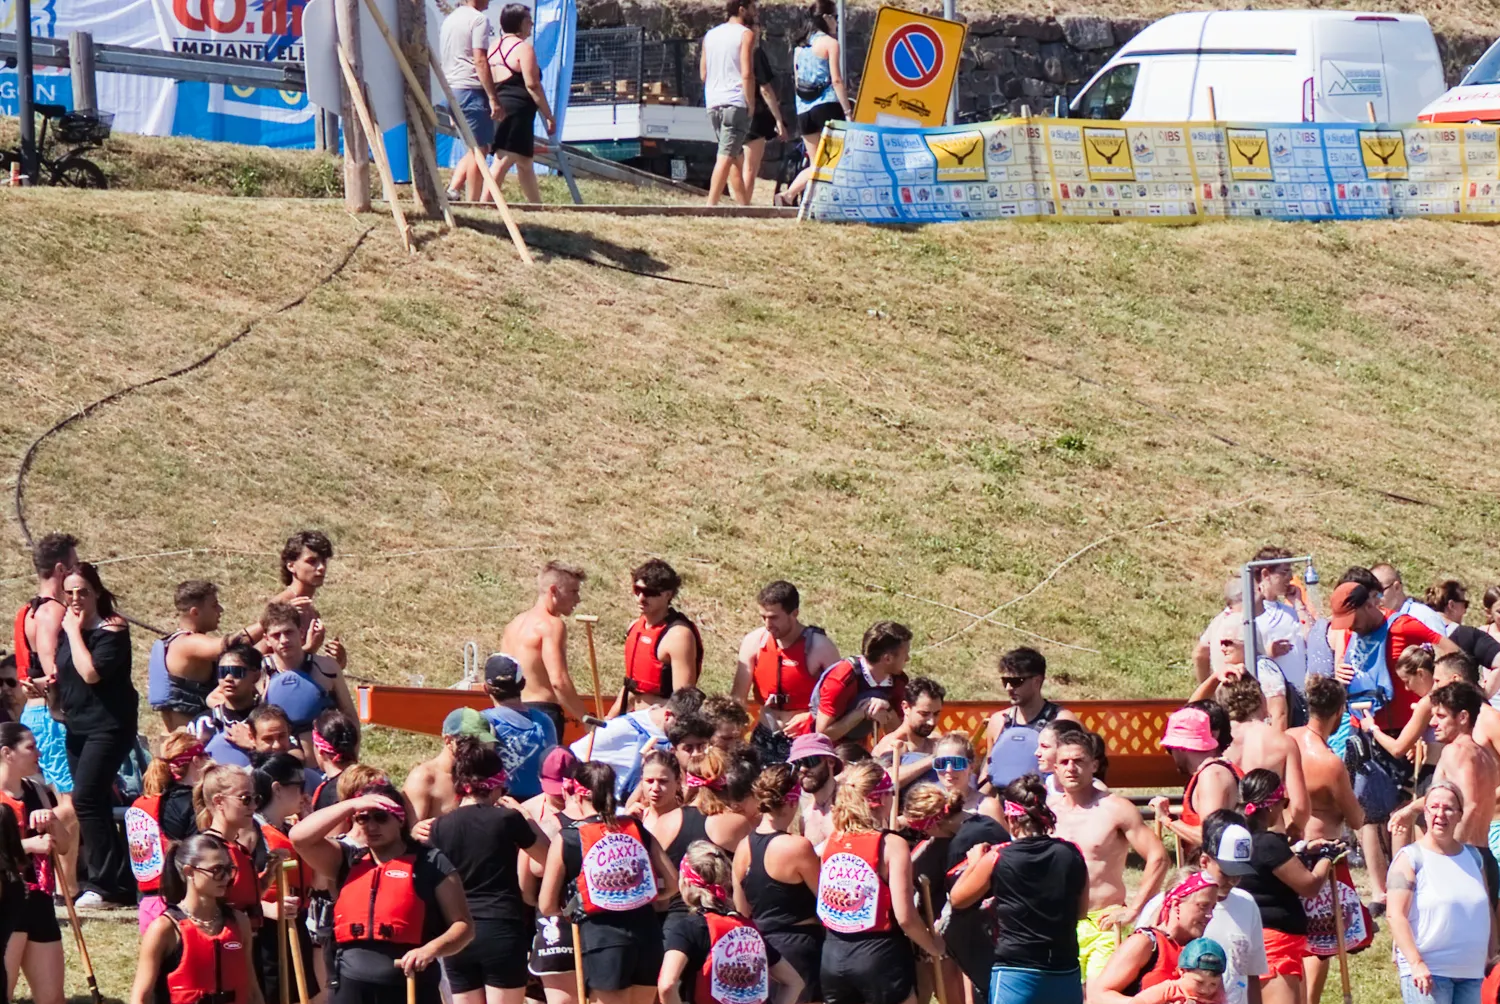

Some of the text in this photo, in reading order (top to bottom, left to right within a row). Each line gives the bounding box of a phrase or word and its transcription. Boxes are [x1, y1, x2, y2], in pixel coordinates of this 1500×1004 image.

[173, 41, 269, 61] IMPIANTI
[595, 834, 634, 851] NA BARCA
[597, 843, 638, 867] CAXXI
[841, 854, 867, 869] BARCA
[828, 866, 870, 882] CAXXI
[1304, 887, 1348, 912] CAXI
[727, 926, 759, 941] NA BARCA
[538, 946, 574, 957] PLAYBOY
[725, 940, 762, 959] CAXXI
